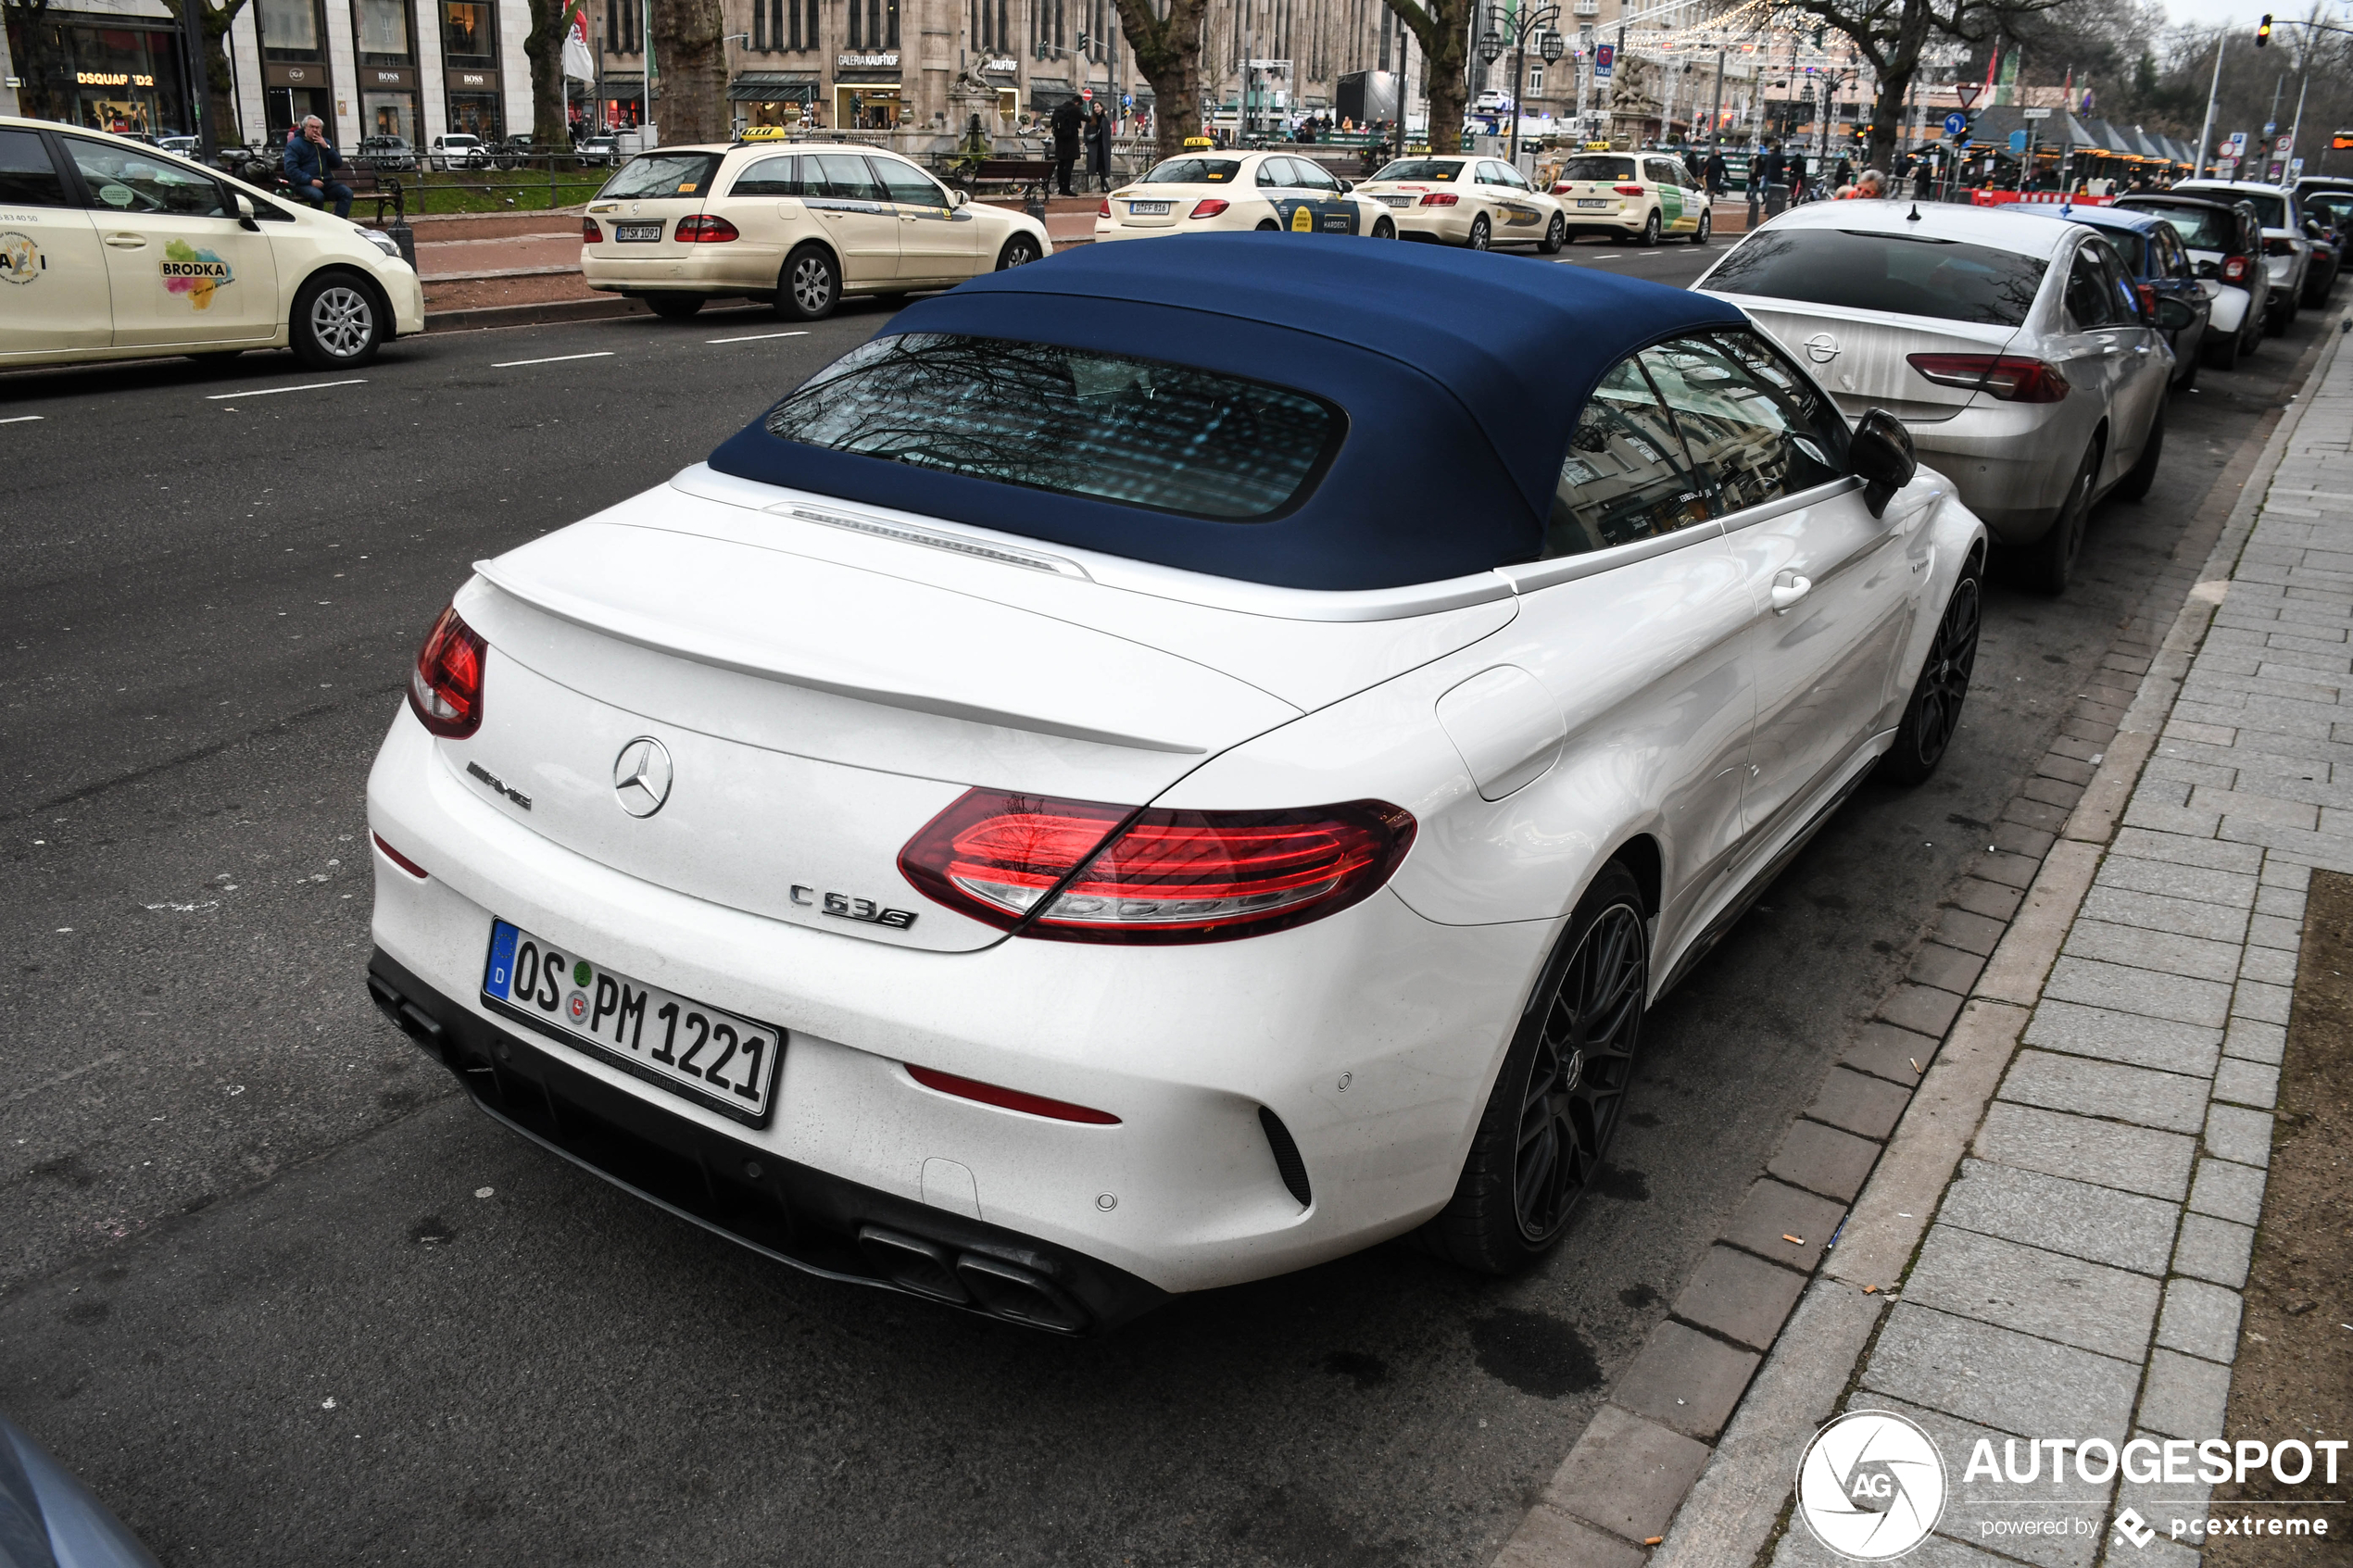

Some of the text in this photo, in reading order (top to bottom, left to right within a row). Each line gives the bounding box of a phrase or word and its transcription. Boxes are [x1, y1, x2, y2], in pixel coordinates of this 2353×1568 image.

[838, 55, 864, 66] GALERIA
[1596, 66, 1611, 75] TAXI
[77, 72, 154, 86] DSQUARD2
[378, 72, 399, 81] BOSS
[463, 74, 484, 82] BOSS
[742, 128, 774, 136] TAXI
[1187, 137, 1204, 146] TAXI
[1143, 204, 1153, 212] FF
[1154, 204, 1166, 212] 816
[629, 227, 639, 239] SK
[640, 228, 659, 239] 1091
[162, 263, 225, 276] BRODKA
[790, 884, 814, 907] C
[495, 967, 505, 985] D
[513, 940, 566, 1012] OS
[590, 972, 648, 1050] PM
[650, 1001, 766, 1102] 1221
[571, 1035, 678, 1093] Mercedes-Benz Rheinland
